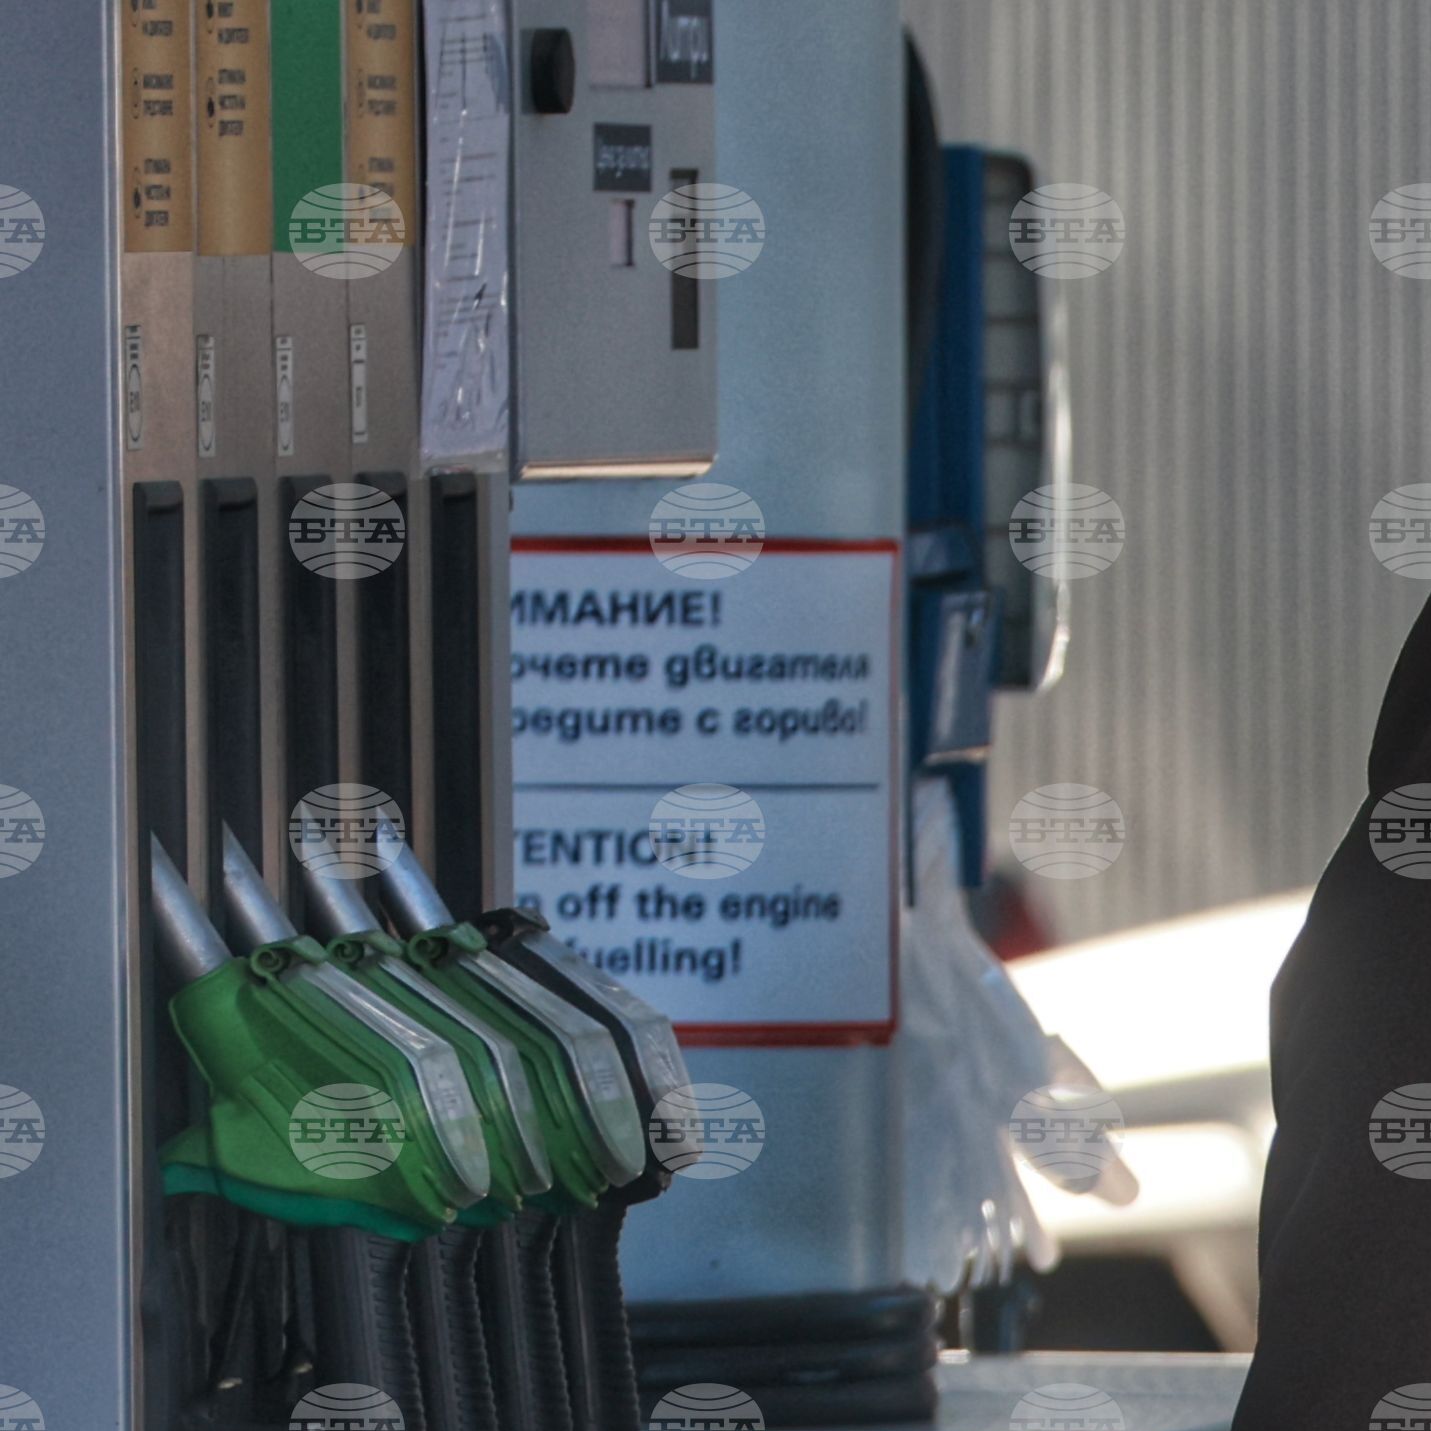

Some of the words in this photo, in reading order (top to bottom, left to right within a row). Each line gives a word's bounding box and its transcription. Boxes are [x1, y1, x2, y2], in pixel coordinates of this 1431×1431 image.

[665, 644, 869, 688] двигателя
[697, 708, 719, 734] с
[734, 698, 868, 742] гориво!
[514, 830, 711, 865] ENTION!
[557, 884, 619, 920] off
[636, 884, 704, 920] the
[719, 884, 841, 928] engine
